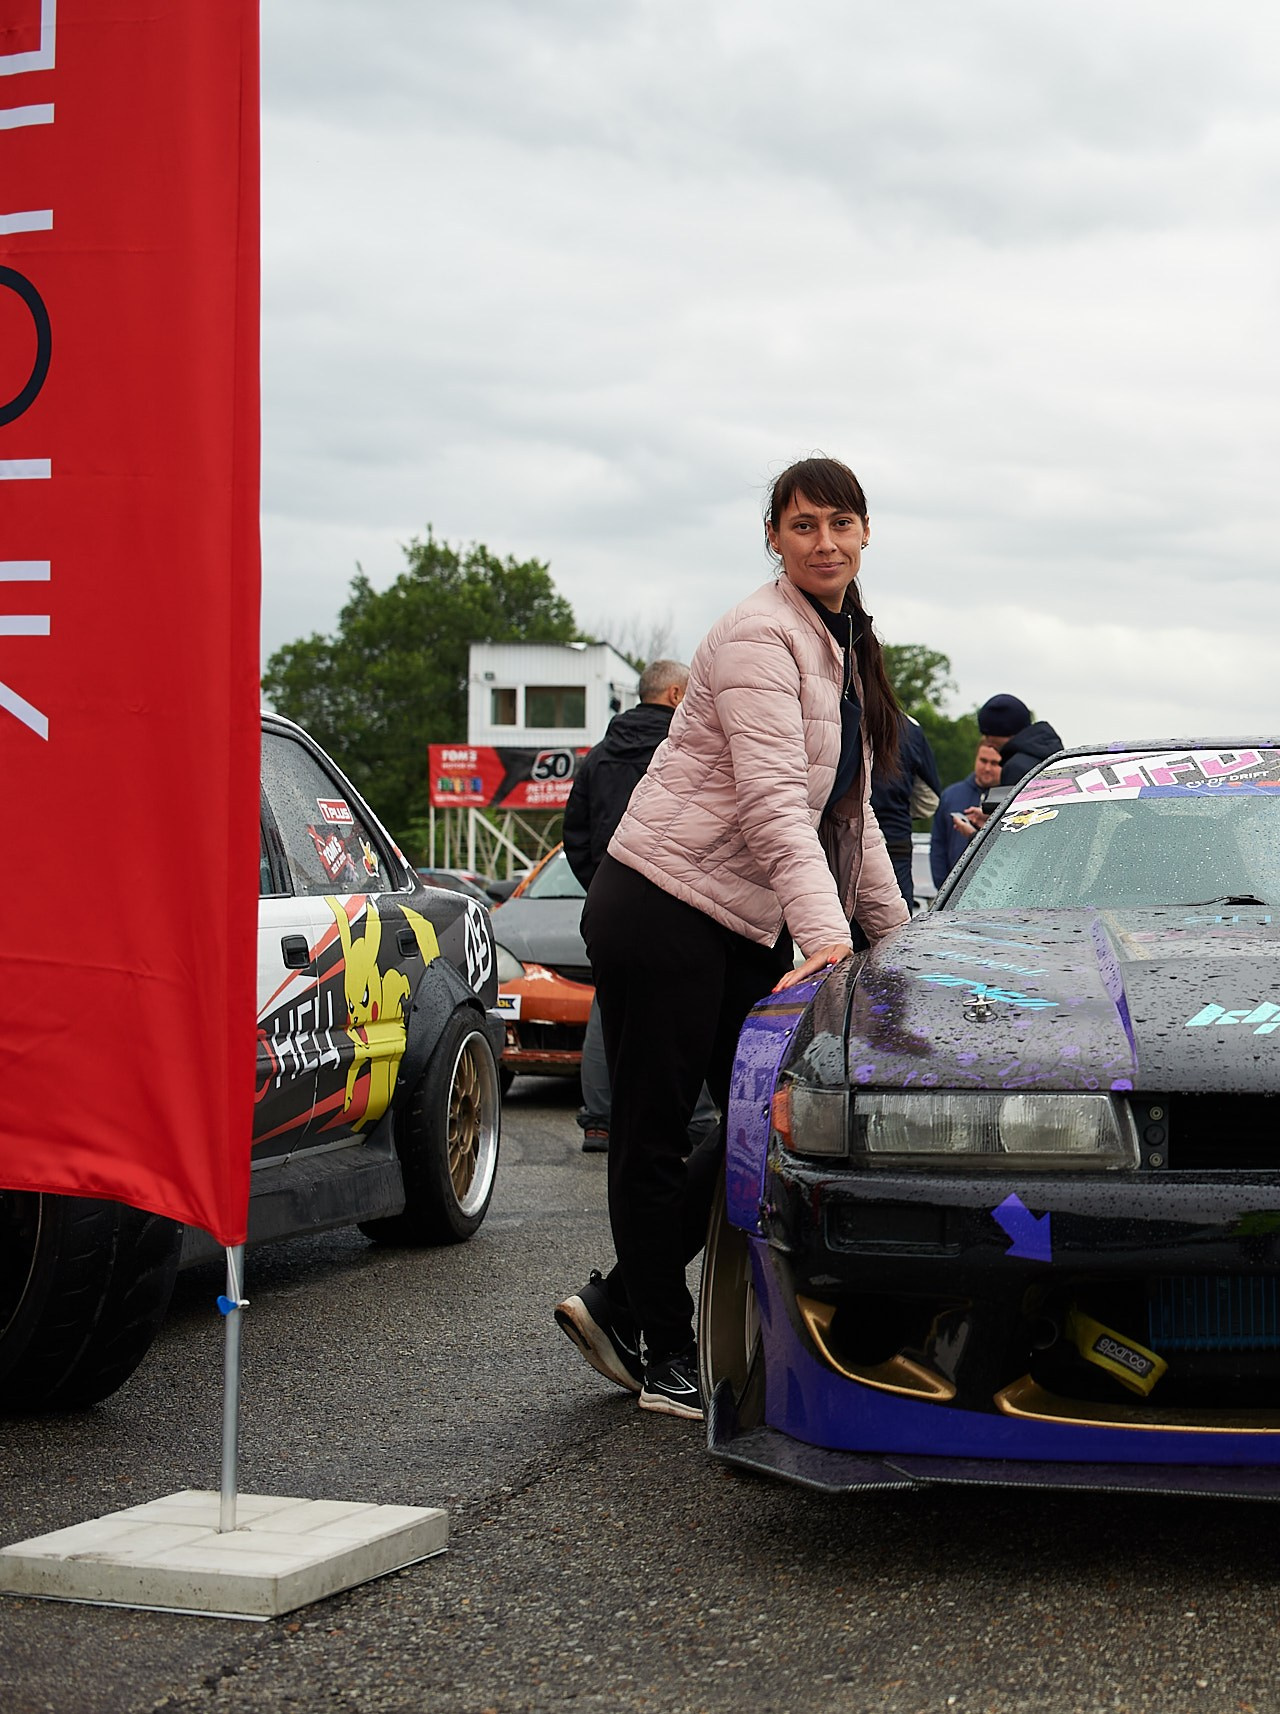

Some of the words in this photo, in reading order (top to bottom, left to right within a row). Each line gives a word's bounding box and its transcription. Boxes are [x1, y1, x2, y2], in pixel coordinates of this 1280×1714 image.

[532, 753, 572, 779] 50
[1229, 771, 1269, 781] DRIFT
[1098, 1337, 1148, 1370] sparco
